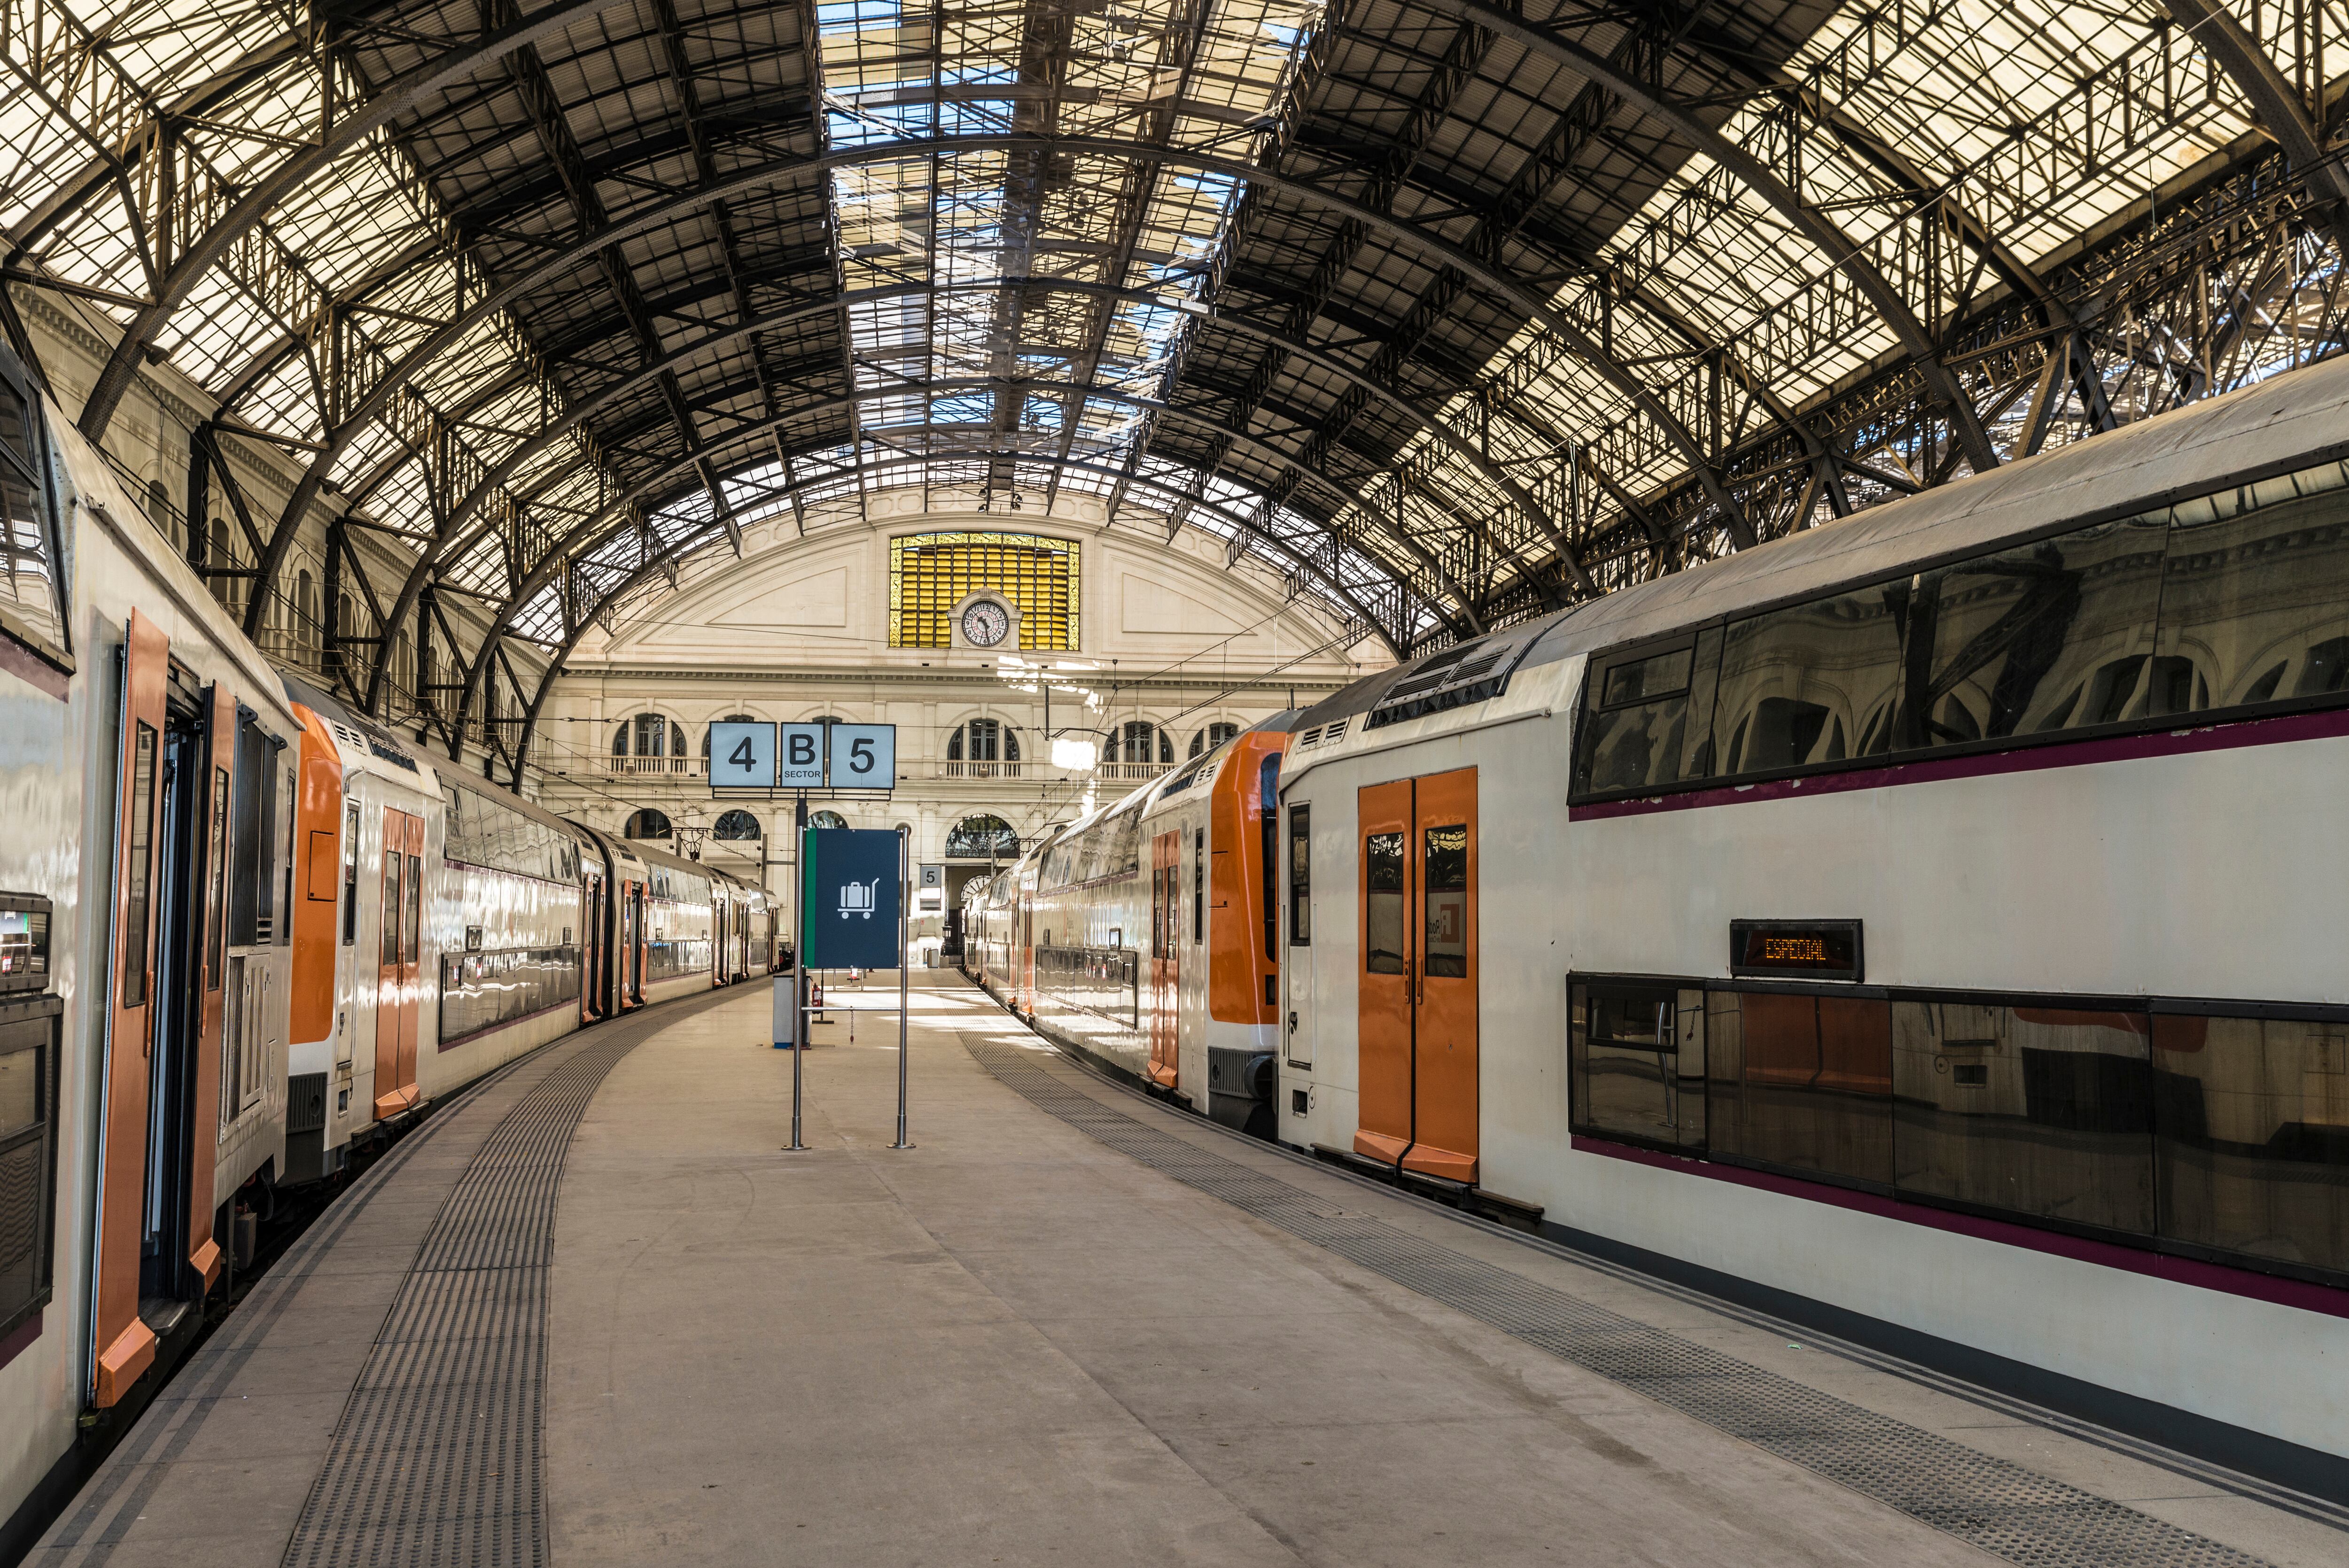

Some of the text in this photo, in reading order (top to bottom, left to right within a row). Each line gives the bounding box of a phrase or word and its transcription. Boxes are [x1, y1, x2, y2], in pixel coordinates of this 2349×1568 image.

[728, 736, 757, 773] 4
[789, 734, 816, 765] B
[849, 738, 875, 774] 5
[926, 871, 935, 883] 5
[1766, 939, 1826, 960] ESPECIAL
